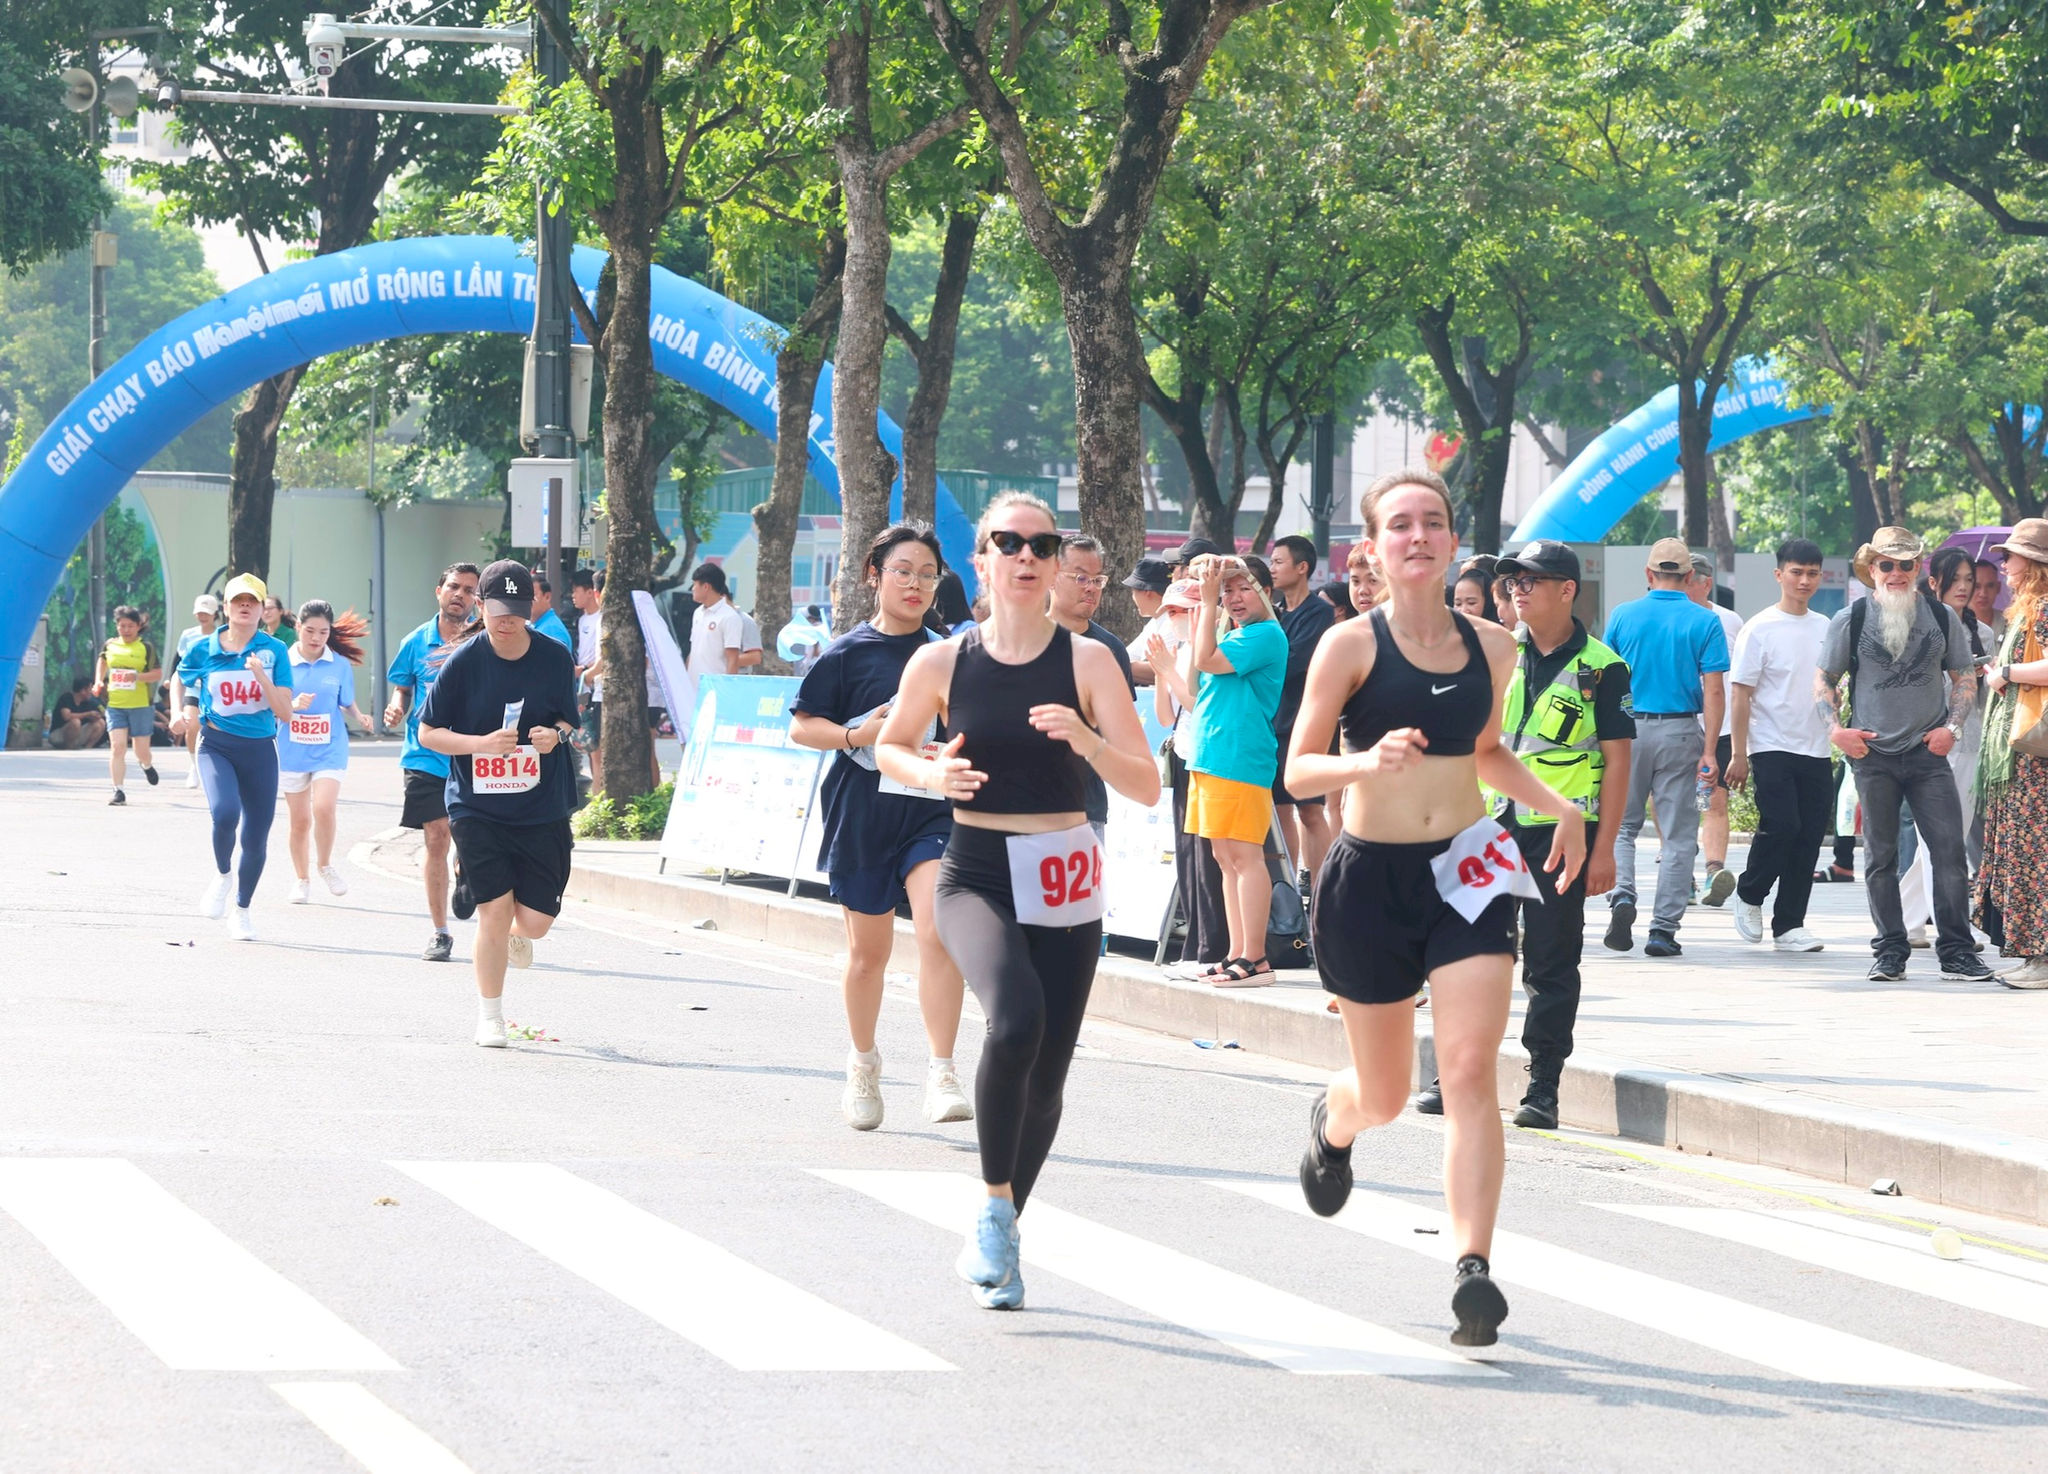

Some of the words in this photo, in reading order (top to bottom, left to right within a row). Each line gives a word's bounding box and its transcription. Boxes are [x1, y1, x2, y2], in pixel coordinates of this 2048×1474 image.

[46, 424, 93, 476] GIẢI
[87, 373, 146, 433] CHẠY
[145, 340, 196, 388] BÁO
[329, 267, 370, 309] MỞ
[377, 267, 446, 304] RỘNG
[453, 261, 503, 298] LẦN
[513, 272, 537, 302] TH
[649, 313, 699, 360] HÒA
[703, 341, 766, 396] BÌNH
[505, 576, 518, 594] LA
[220, 681, 262, 706] 944
[291, 720, 330, 735] 8820
[475, 757, 538, 778] 8814
